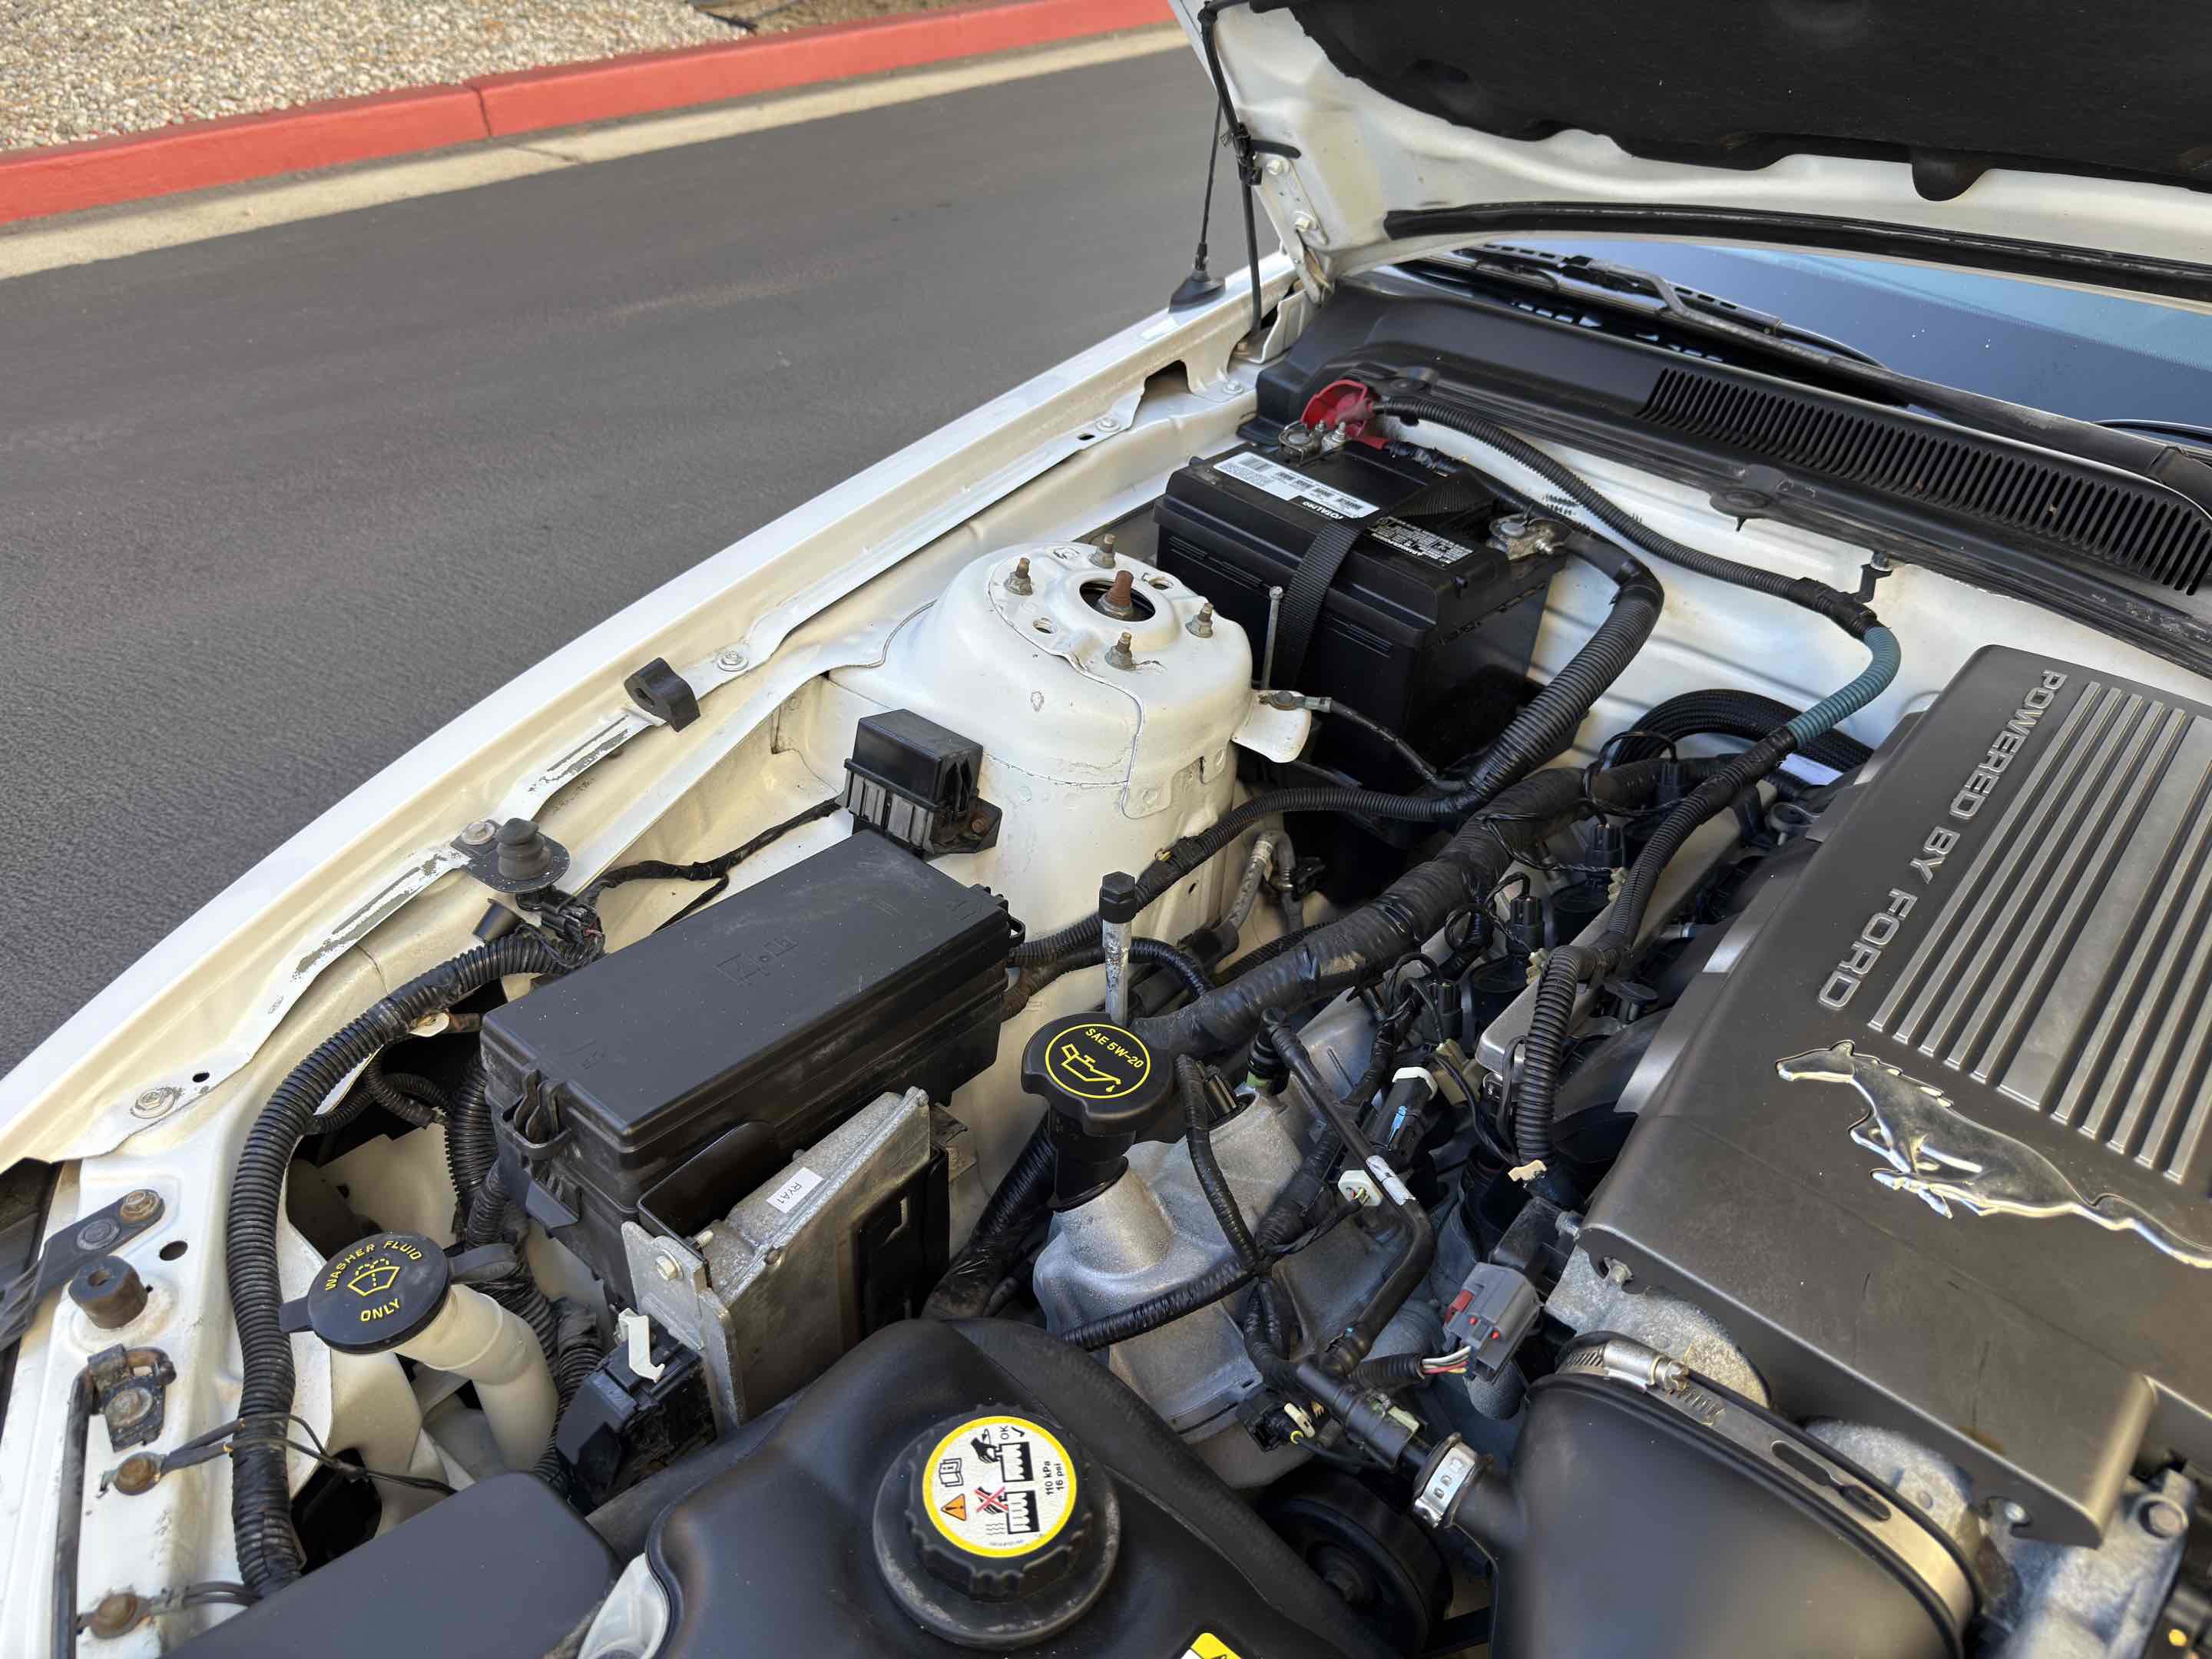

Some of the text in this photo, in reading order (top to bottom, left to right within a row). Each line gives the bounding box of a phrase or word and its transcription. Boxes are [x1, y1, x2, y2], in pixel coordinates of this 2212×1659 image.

[1818, 669, 2068, 1012] POWERED BY FORD
[1084, 1028, 1144, 1068] SAE 5W-20
[776, 1181, 803, 1204] RYA1
[326, 1240, 423, 1291] WASHER FLUID
[360, 1298, 400, 1322] ONLY
[999, 1426, 1009, 1440] OK
[1042, 1461, 1055, 1496] 110 kPa
[1054, 1462, 1065, 1491] 16 psi
